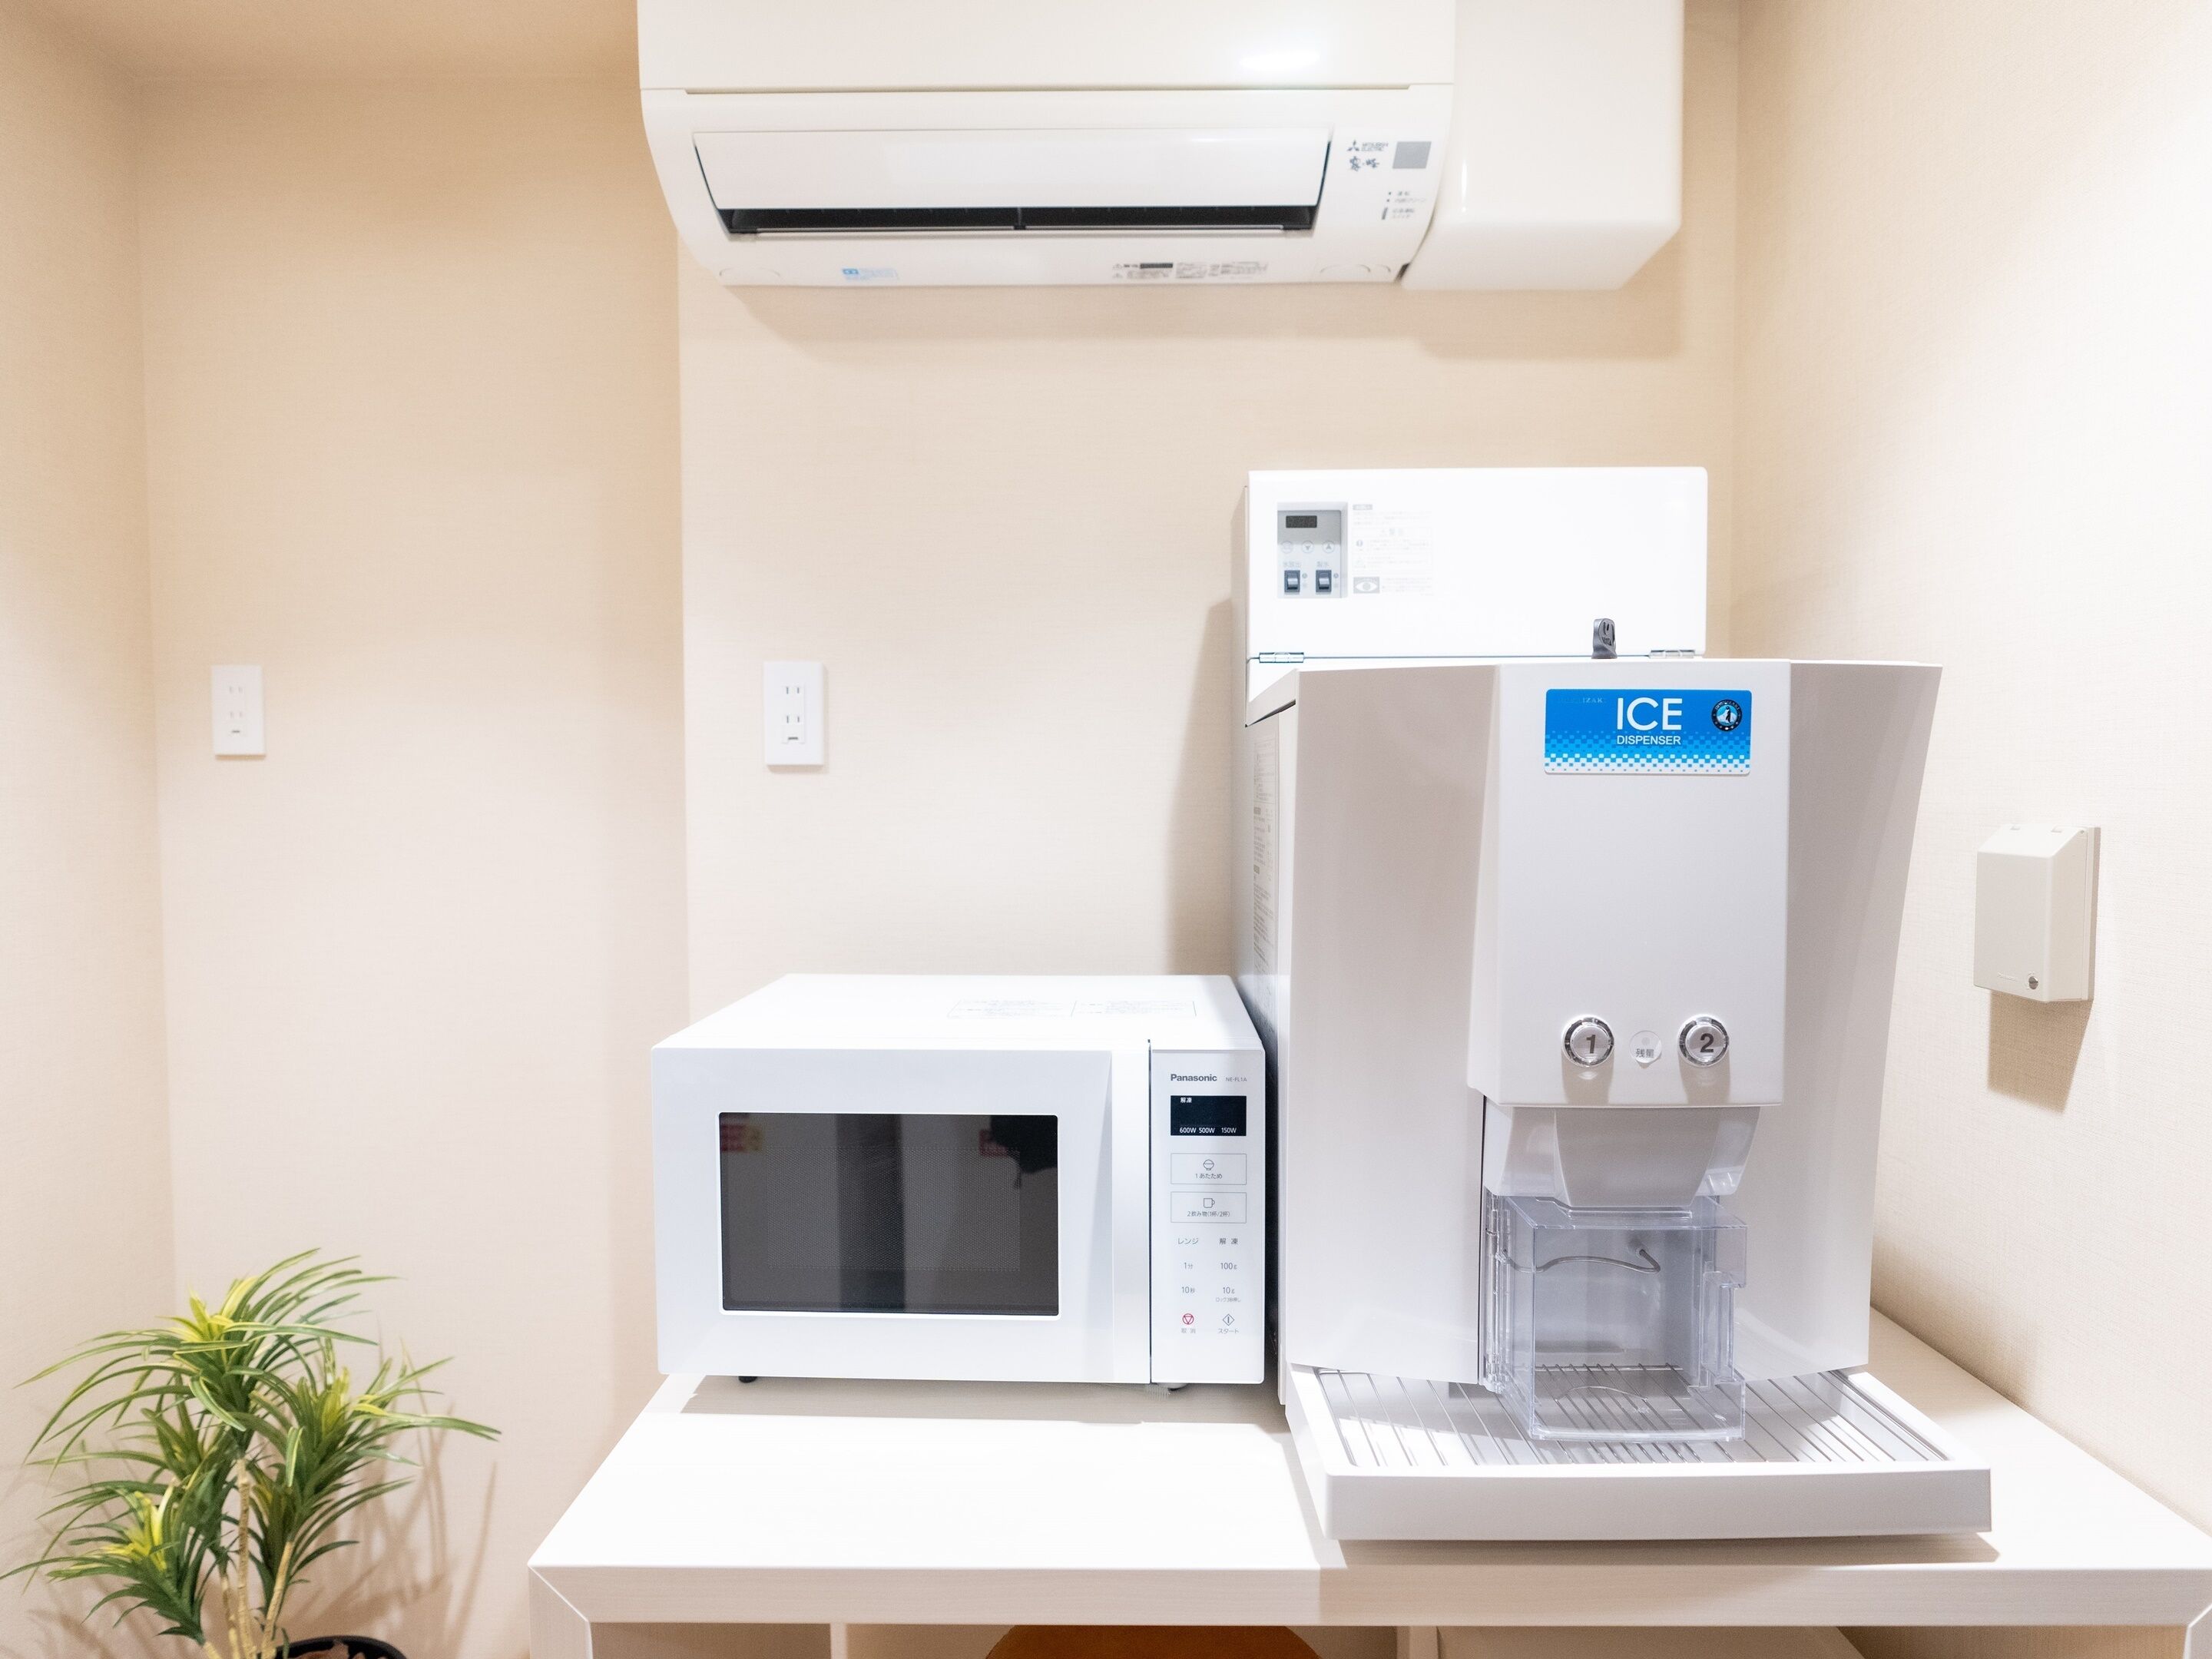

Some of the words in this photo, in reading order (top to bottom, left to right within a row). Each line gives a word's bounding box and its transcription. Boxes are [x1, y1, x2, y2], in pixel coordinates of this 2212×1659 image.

[1617, 697, 1683, 730] ICE
[1617, 735, 1681, 745] DISPENSER
[1586, 1034, 1597, 1054] 1
[1700, 1033, 1714, 1053] 2
[1635, 1048, 1654, 1058] 残量
[1170, 1073, 1217, 1082] Panasonic
